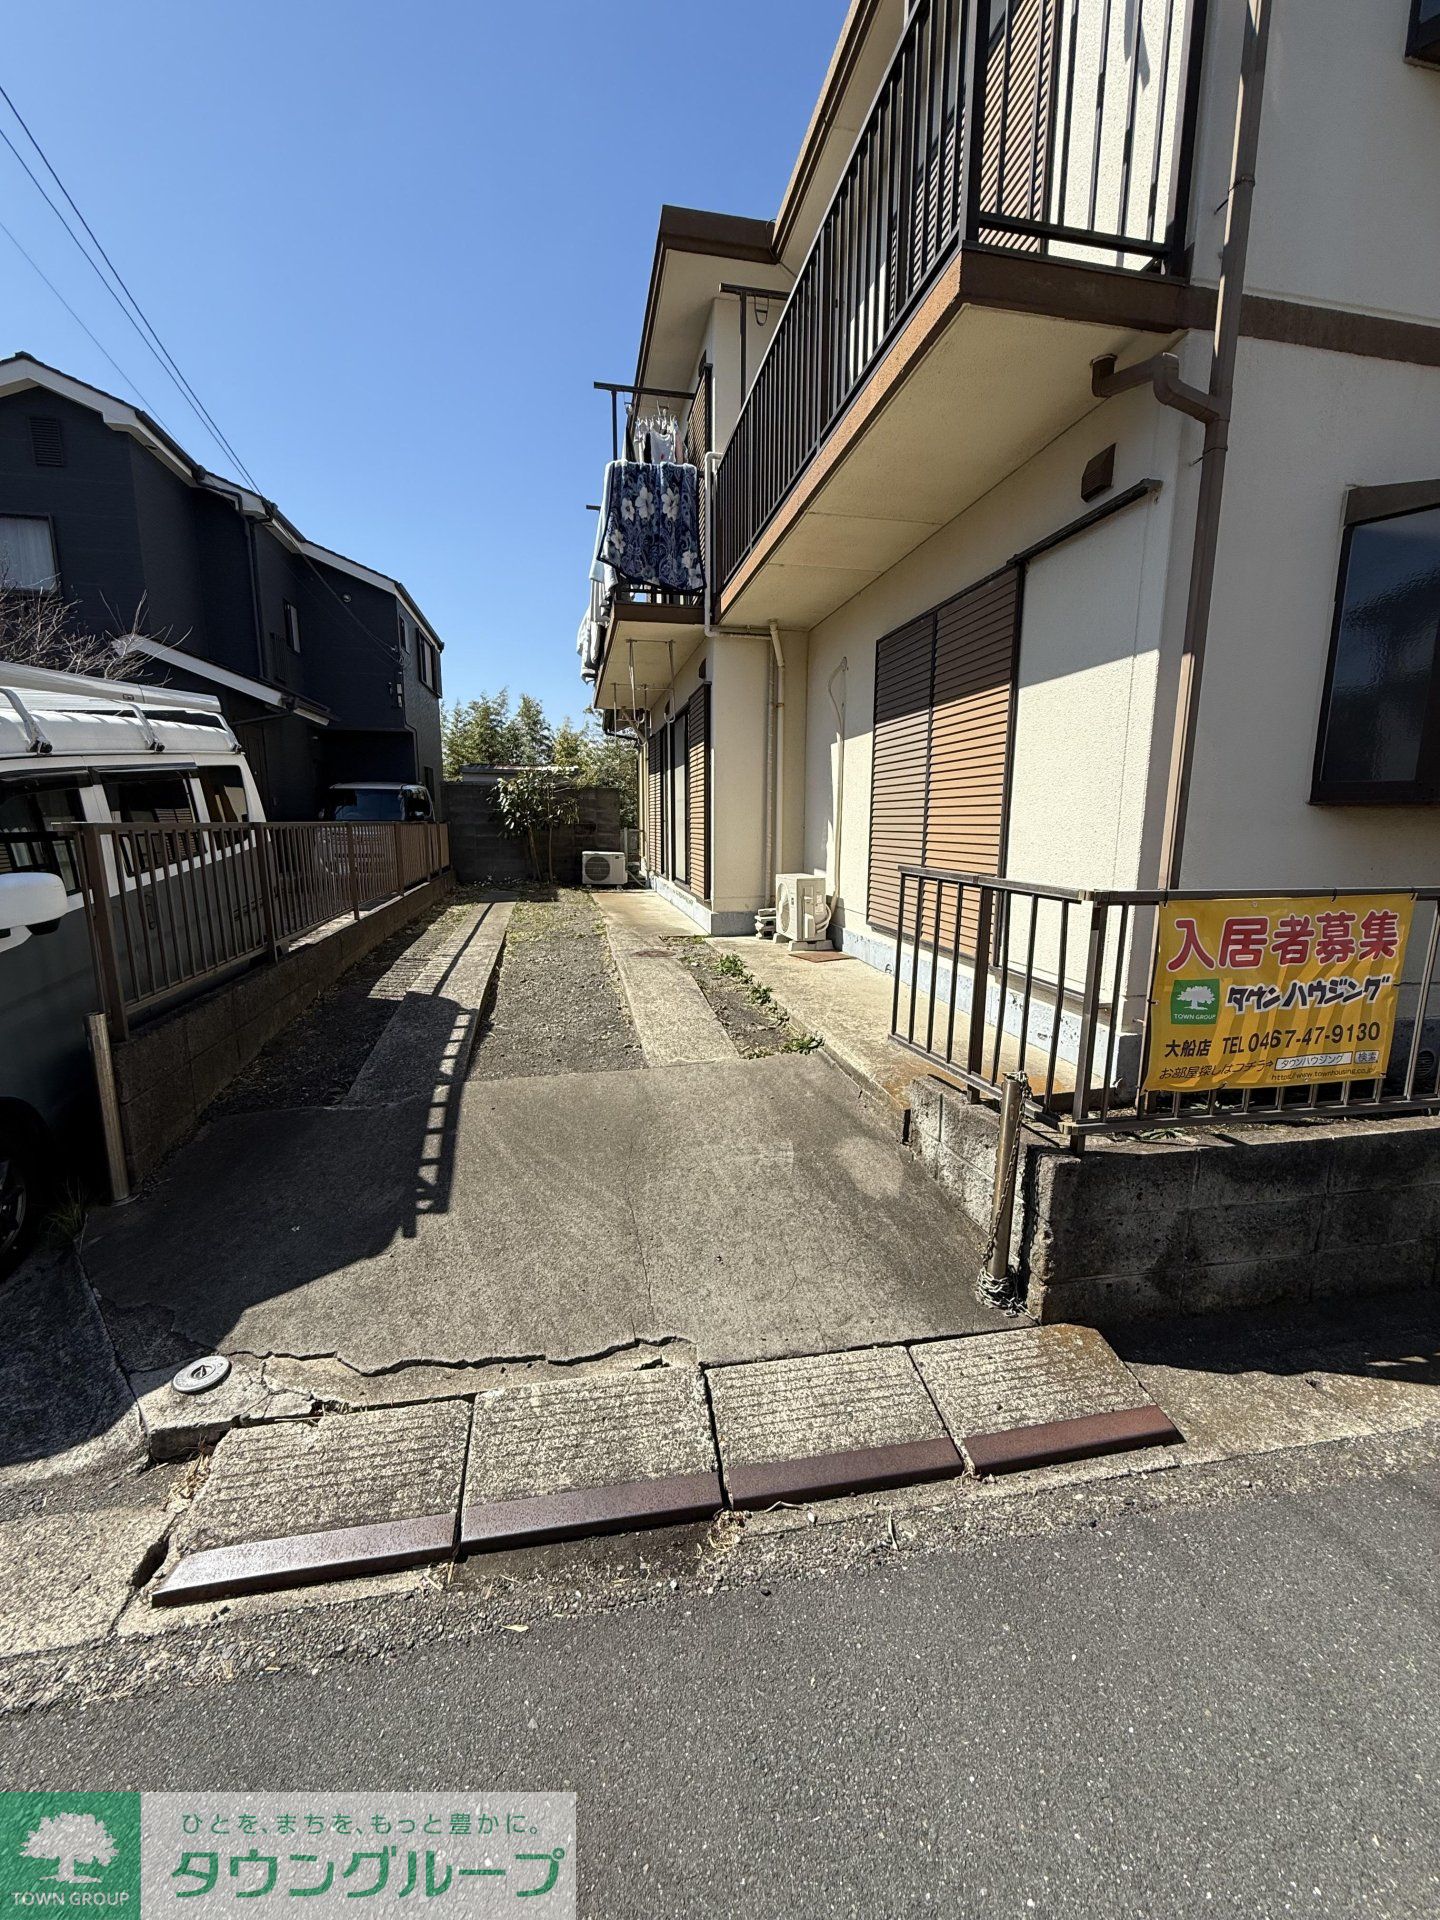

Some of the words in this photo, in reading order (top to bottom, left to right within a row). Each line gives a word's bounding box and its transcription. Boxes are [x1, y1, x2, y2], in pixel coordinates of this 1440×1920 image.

[1166, 909, 1400, 972] 入居者募集
[1226, 975, 1390, 1014] タウンハウジング
[1174, 1013, 1195, 1021] TOWN
[1196, 1013, 1217, 1021] GROUP
[1164, 1039, 1211, 1058] 大船店
[1222, 1037, 1244, 1055] TEL
[1247, 1021, 1380, 1050] 0467-47-9130
[1280, 1054, 1344, 1068] タウンハウジング
[1357, 1051, 1378, 1063] 検索
